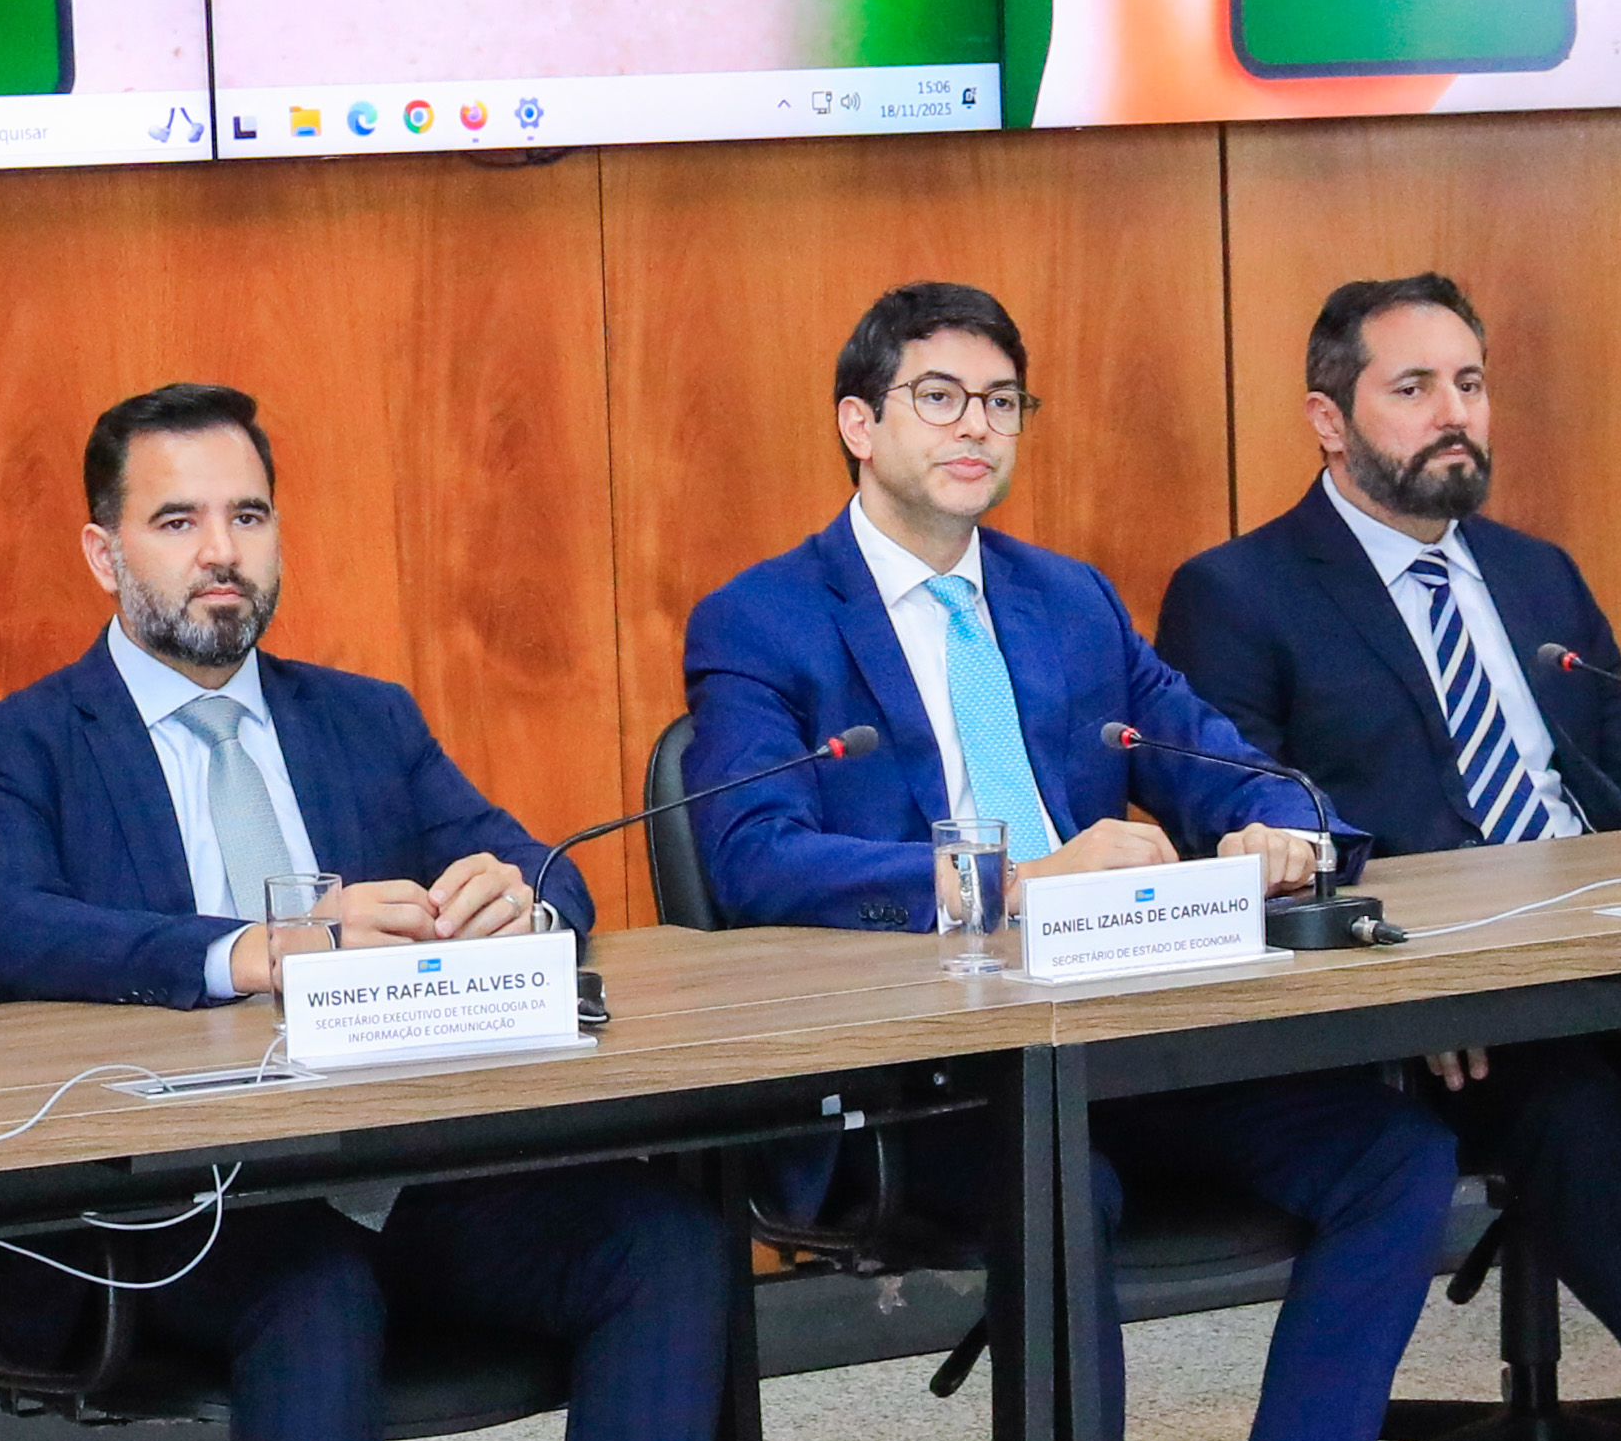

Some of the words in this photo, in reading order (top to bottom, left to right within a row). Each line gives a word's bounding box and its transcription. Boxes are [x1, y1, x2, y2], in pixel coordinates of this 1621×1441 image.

[917, 80, 951, 94] 15:06
[880, 103, 952, 119] 18/11/2025
[1042, 917, 1093, 936] DANIEL
[1098, 911, 1144, 929] IZAIAS
[1148, 908, 1167, 923] DE
[1171, 897, 1249, 919] CARVALHO
[1051, 949, 1115, 967] SECRETÁRIO
[1117, 947, 1131, 958] DE
[1133, 943, 1172, 957] ESTADO
[1174, 940, 1188, 951] DE
[1190, 933, 1242, 949] ECONOMIA
[307, 987, 380, 1008] WISNEY
[386, 979, 460, 1001] RAFAEL
[465, 973, 526, 993] ALVES
[531, 971, 550, 987] O.
[315, 1013, 380, 1030] SECRETÁRIO
[383, 1008, 442, 1023] EXECUTIVO
[444, 1006, 459, 1018] DE
[461, 999, 528, 1016] TECNOLOGIA
[531, 998, 546, 1010] DA
[348, 1026, 422, 1044] INFORMAÇÃO
[425, 1025, 431, 1037] E
[433, 1018, 516, 1036] COMUNICAÇÃO
